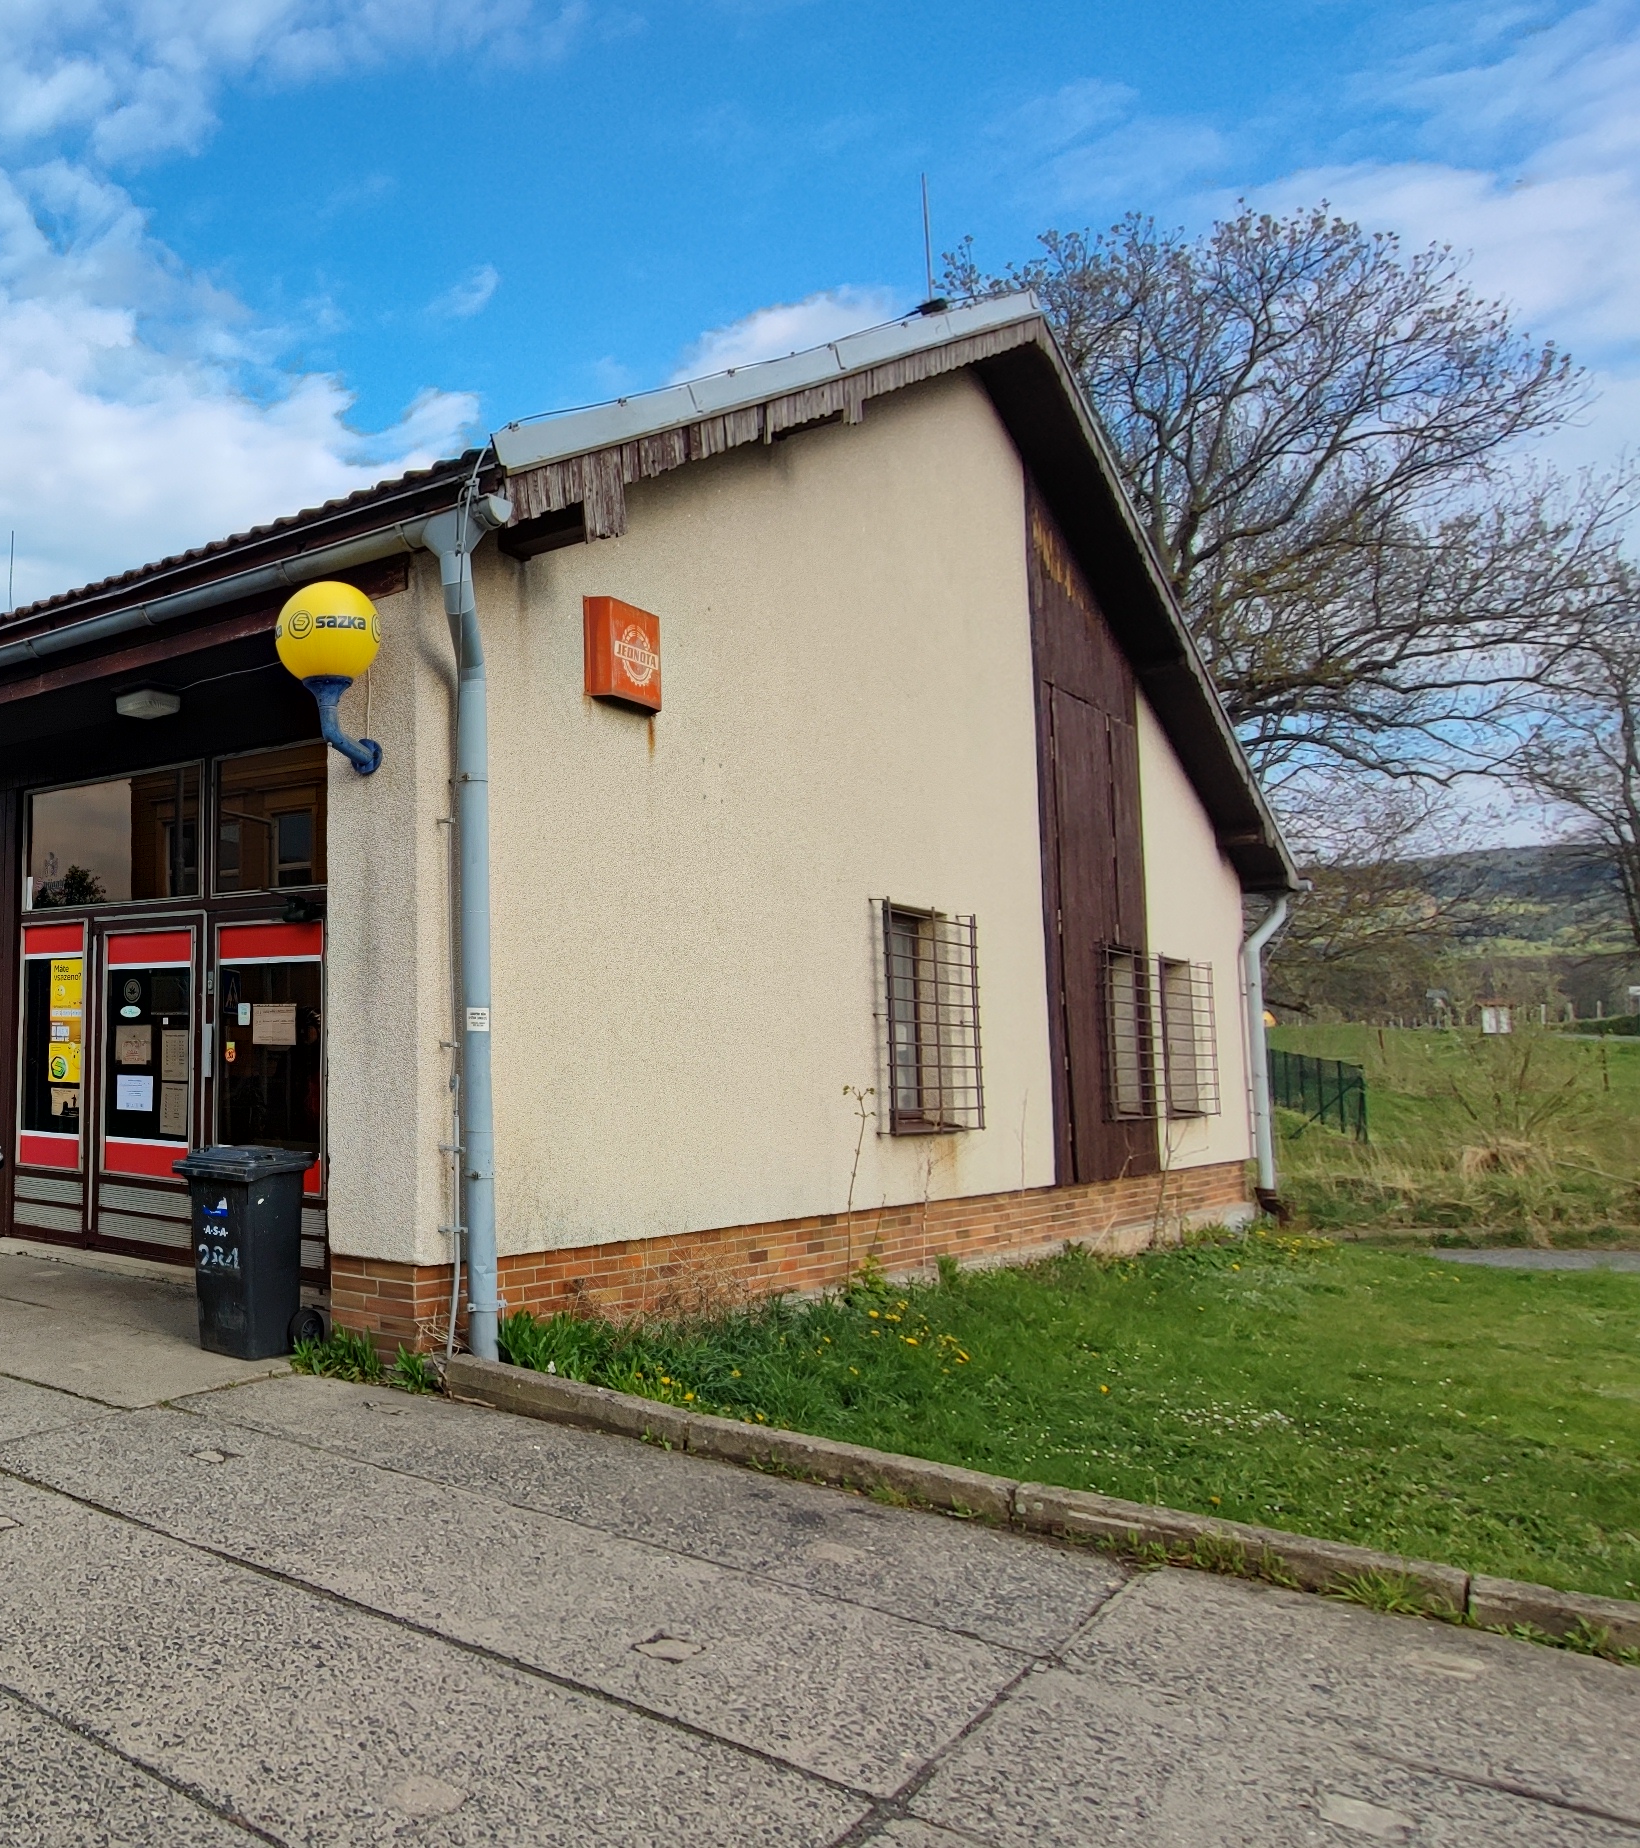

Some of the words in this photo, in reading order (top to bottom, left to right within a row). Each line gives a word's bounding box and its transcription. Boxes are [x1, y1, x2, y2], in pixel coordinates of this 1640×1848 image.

[315, 615, 366, 630] sazka
[616, 643, 657, 669] JEDNOTA
[53, 964, 69, 973] Máte
